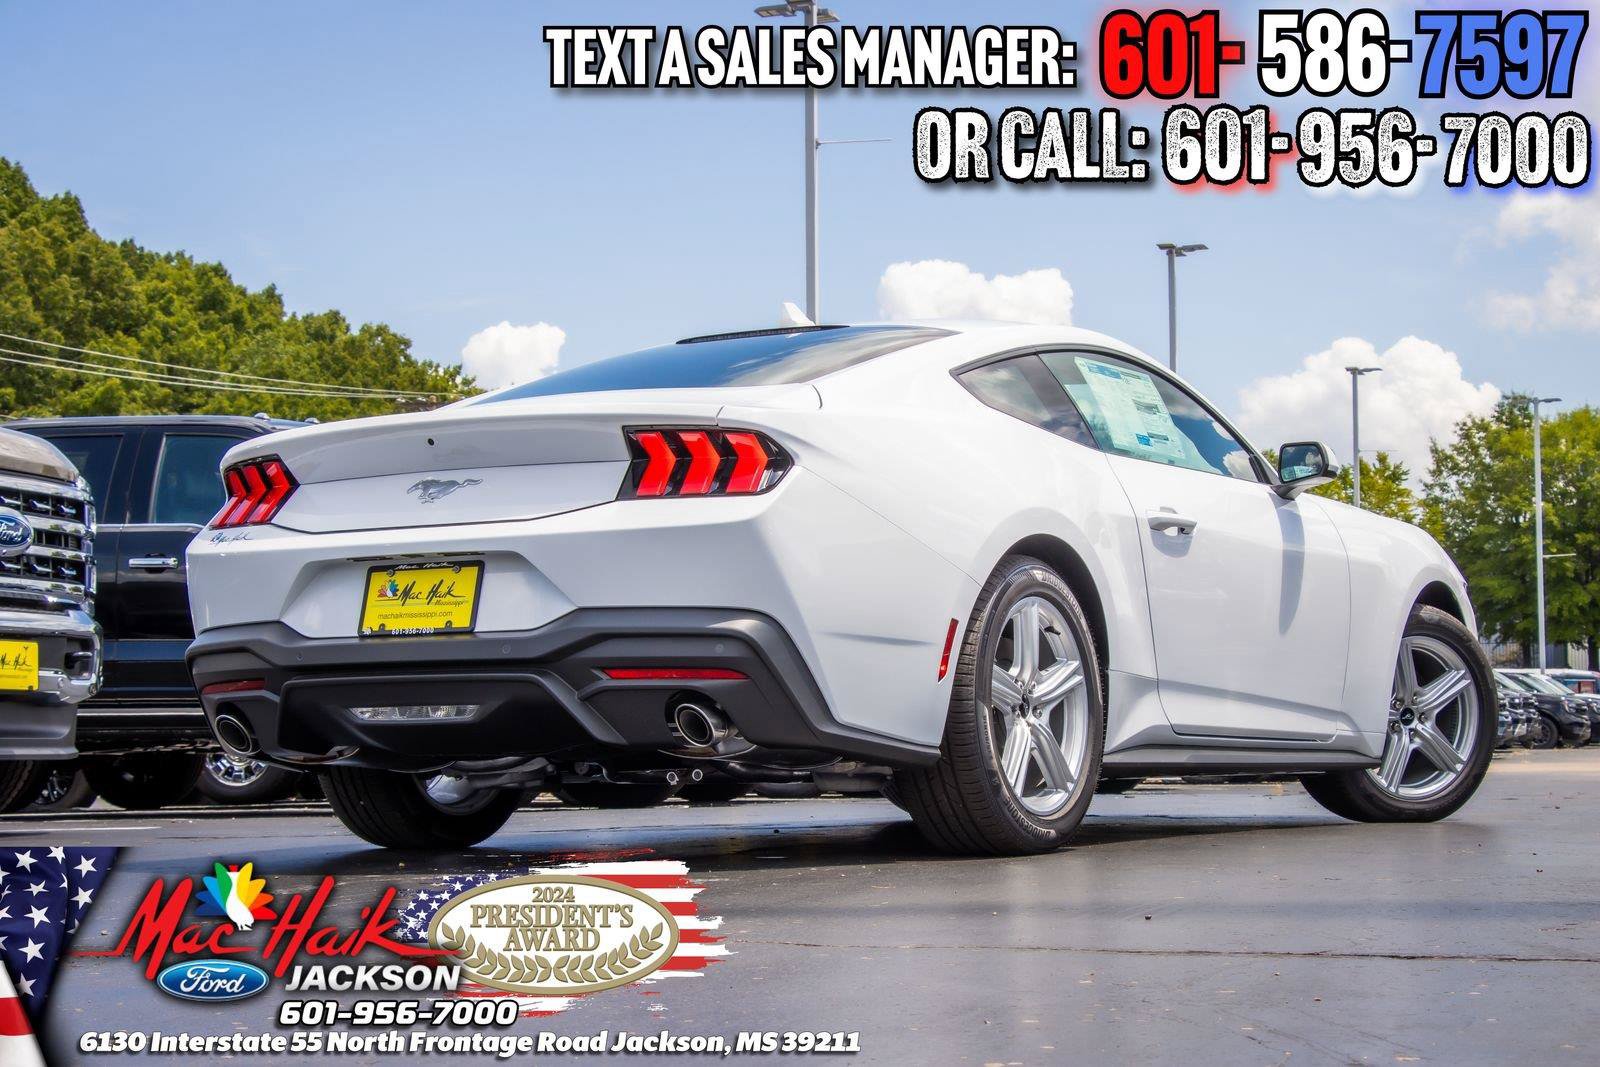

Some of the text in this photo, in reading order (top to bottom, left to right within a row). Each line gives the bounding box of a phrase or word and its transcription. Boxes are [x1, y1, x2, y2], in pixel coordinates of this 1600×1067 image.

[400, 579, 466, 607] Mac Haik
[377, 611, 453, 620] machaikmississippi.com
